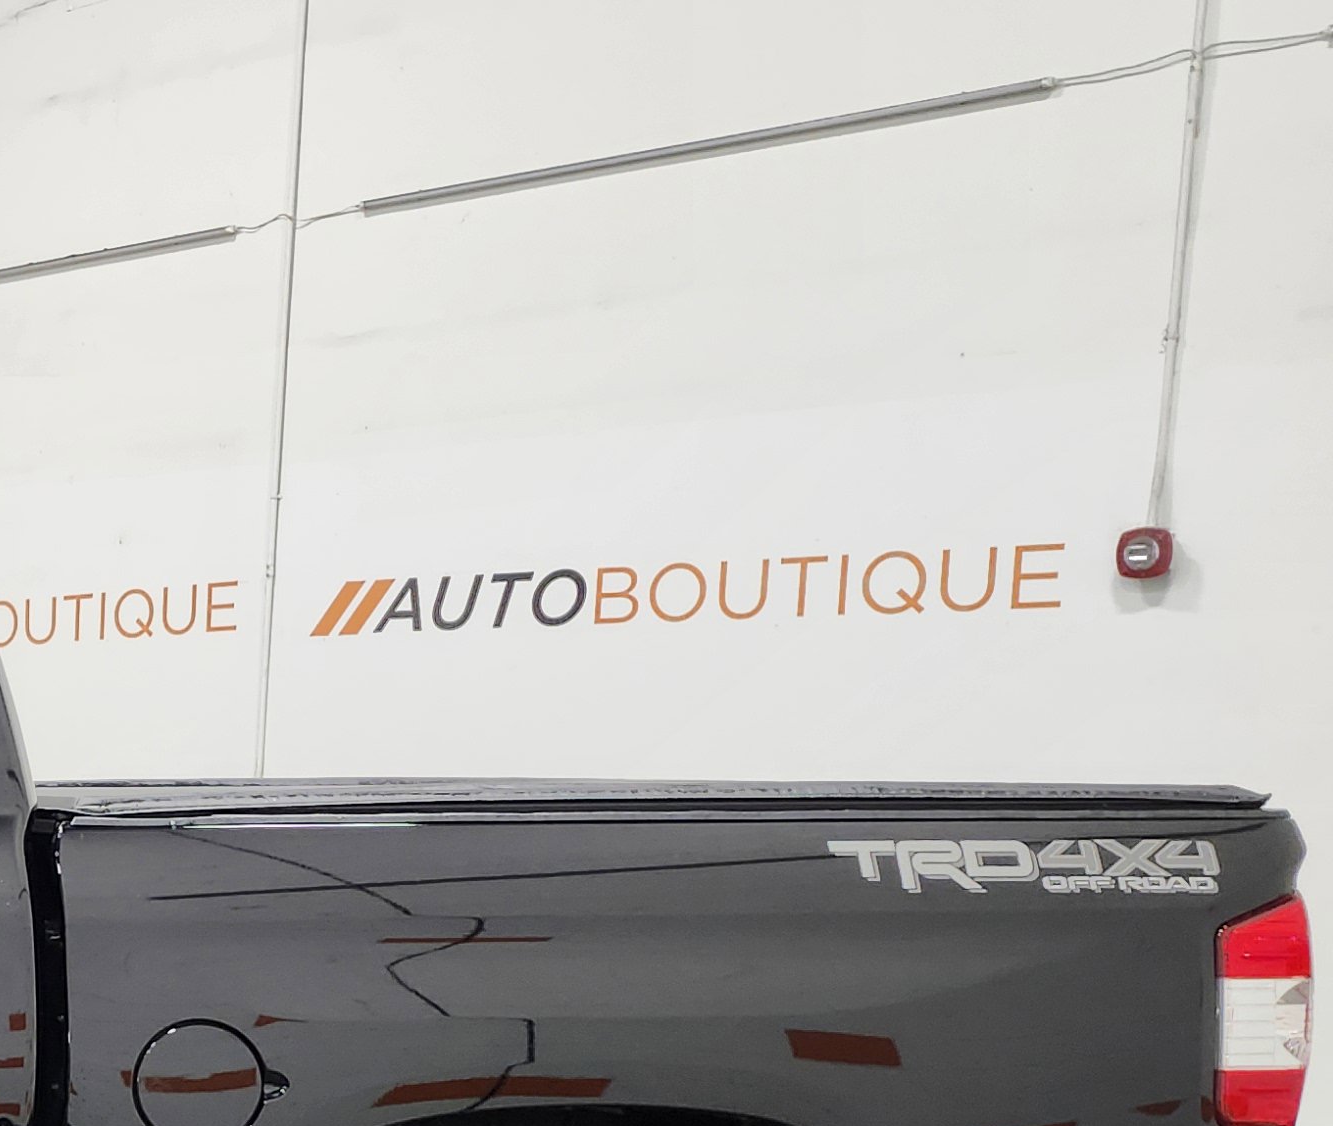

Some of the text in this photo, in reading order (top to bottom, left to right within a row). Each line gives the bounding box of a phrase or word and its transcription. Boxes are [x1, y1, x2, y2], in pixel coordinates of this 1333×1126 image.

[373, 542, 1068, 635] AUTOBOUTIQUE
[826, 839, 1040, 893] TRD
[1042, 876, 1219, 894] OFF ROAD
